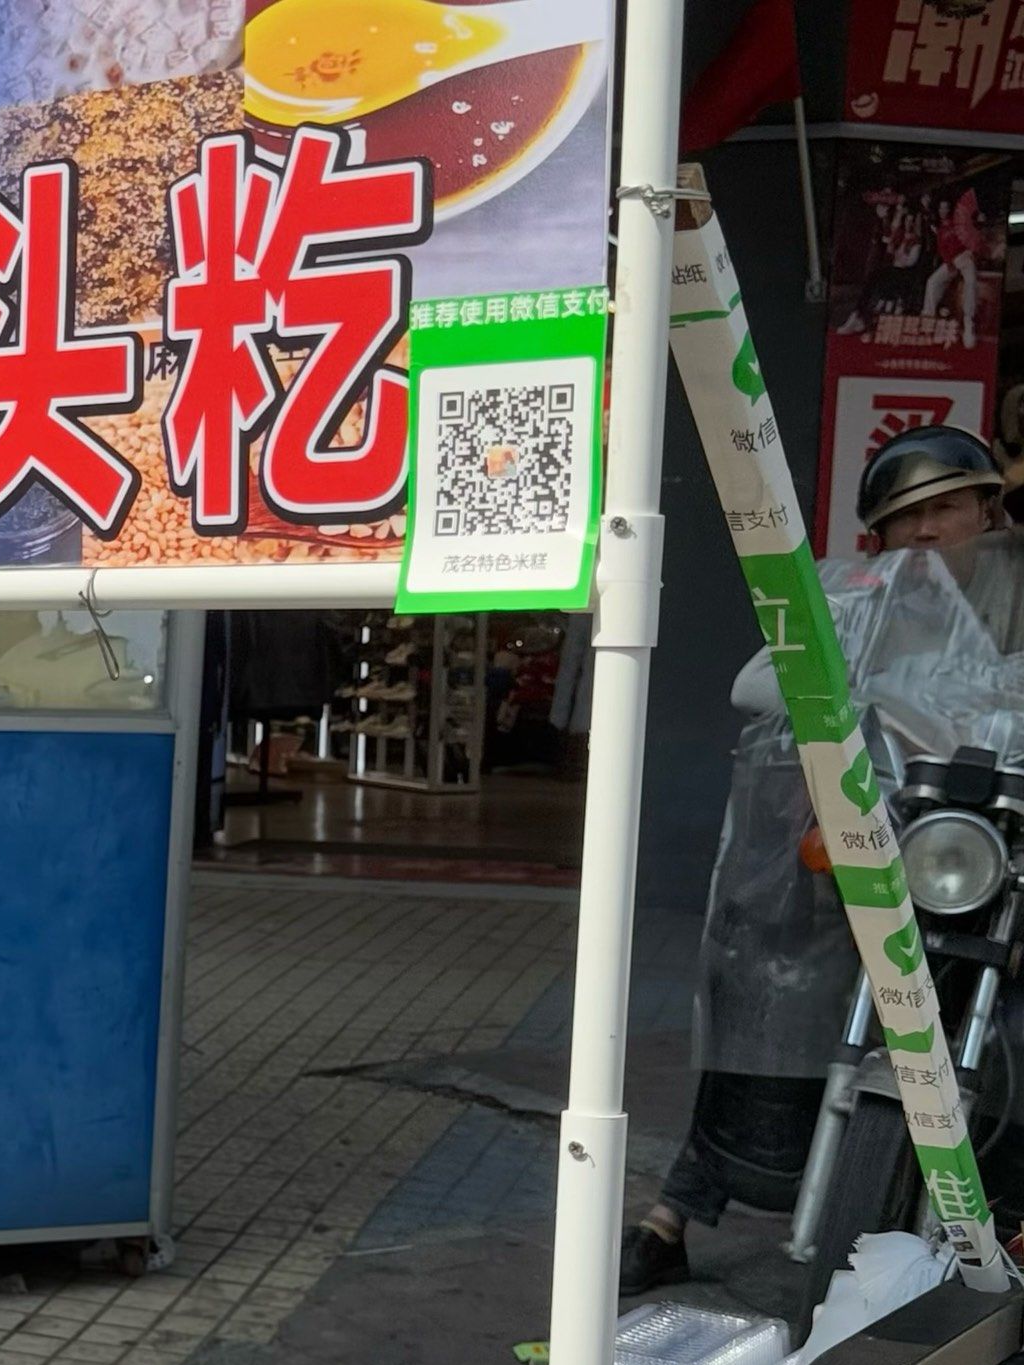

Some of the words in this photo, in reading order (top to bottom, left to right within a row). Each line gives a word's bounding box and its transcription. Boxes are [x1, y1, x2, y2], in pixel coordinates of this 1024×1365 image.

[410, 287, 610, 331] 推荐使用微信支付
[442, 553, 548, 574] 茂名特色米糕
